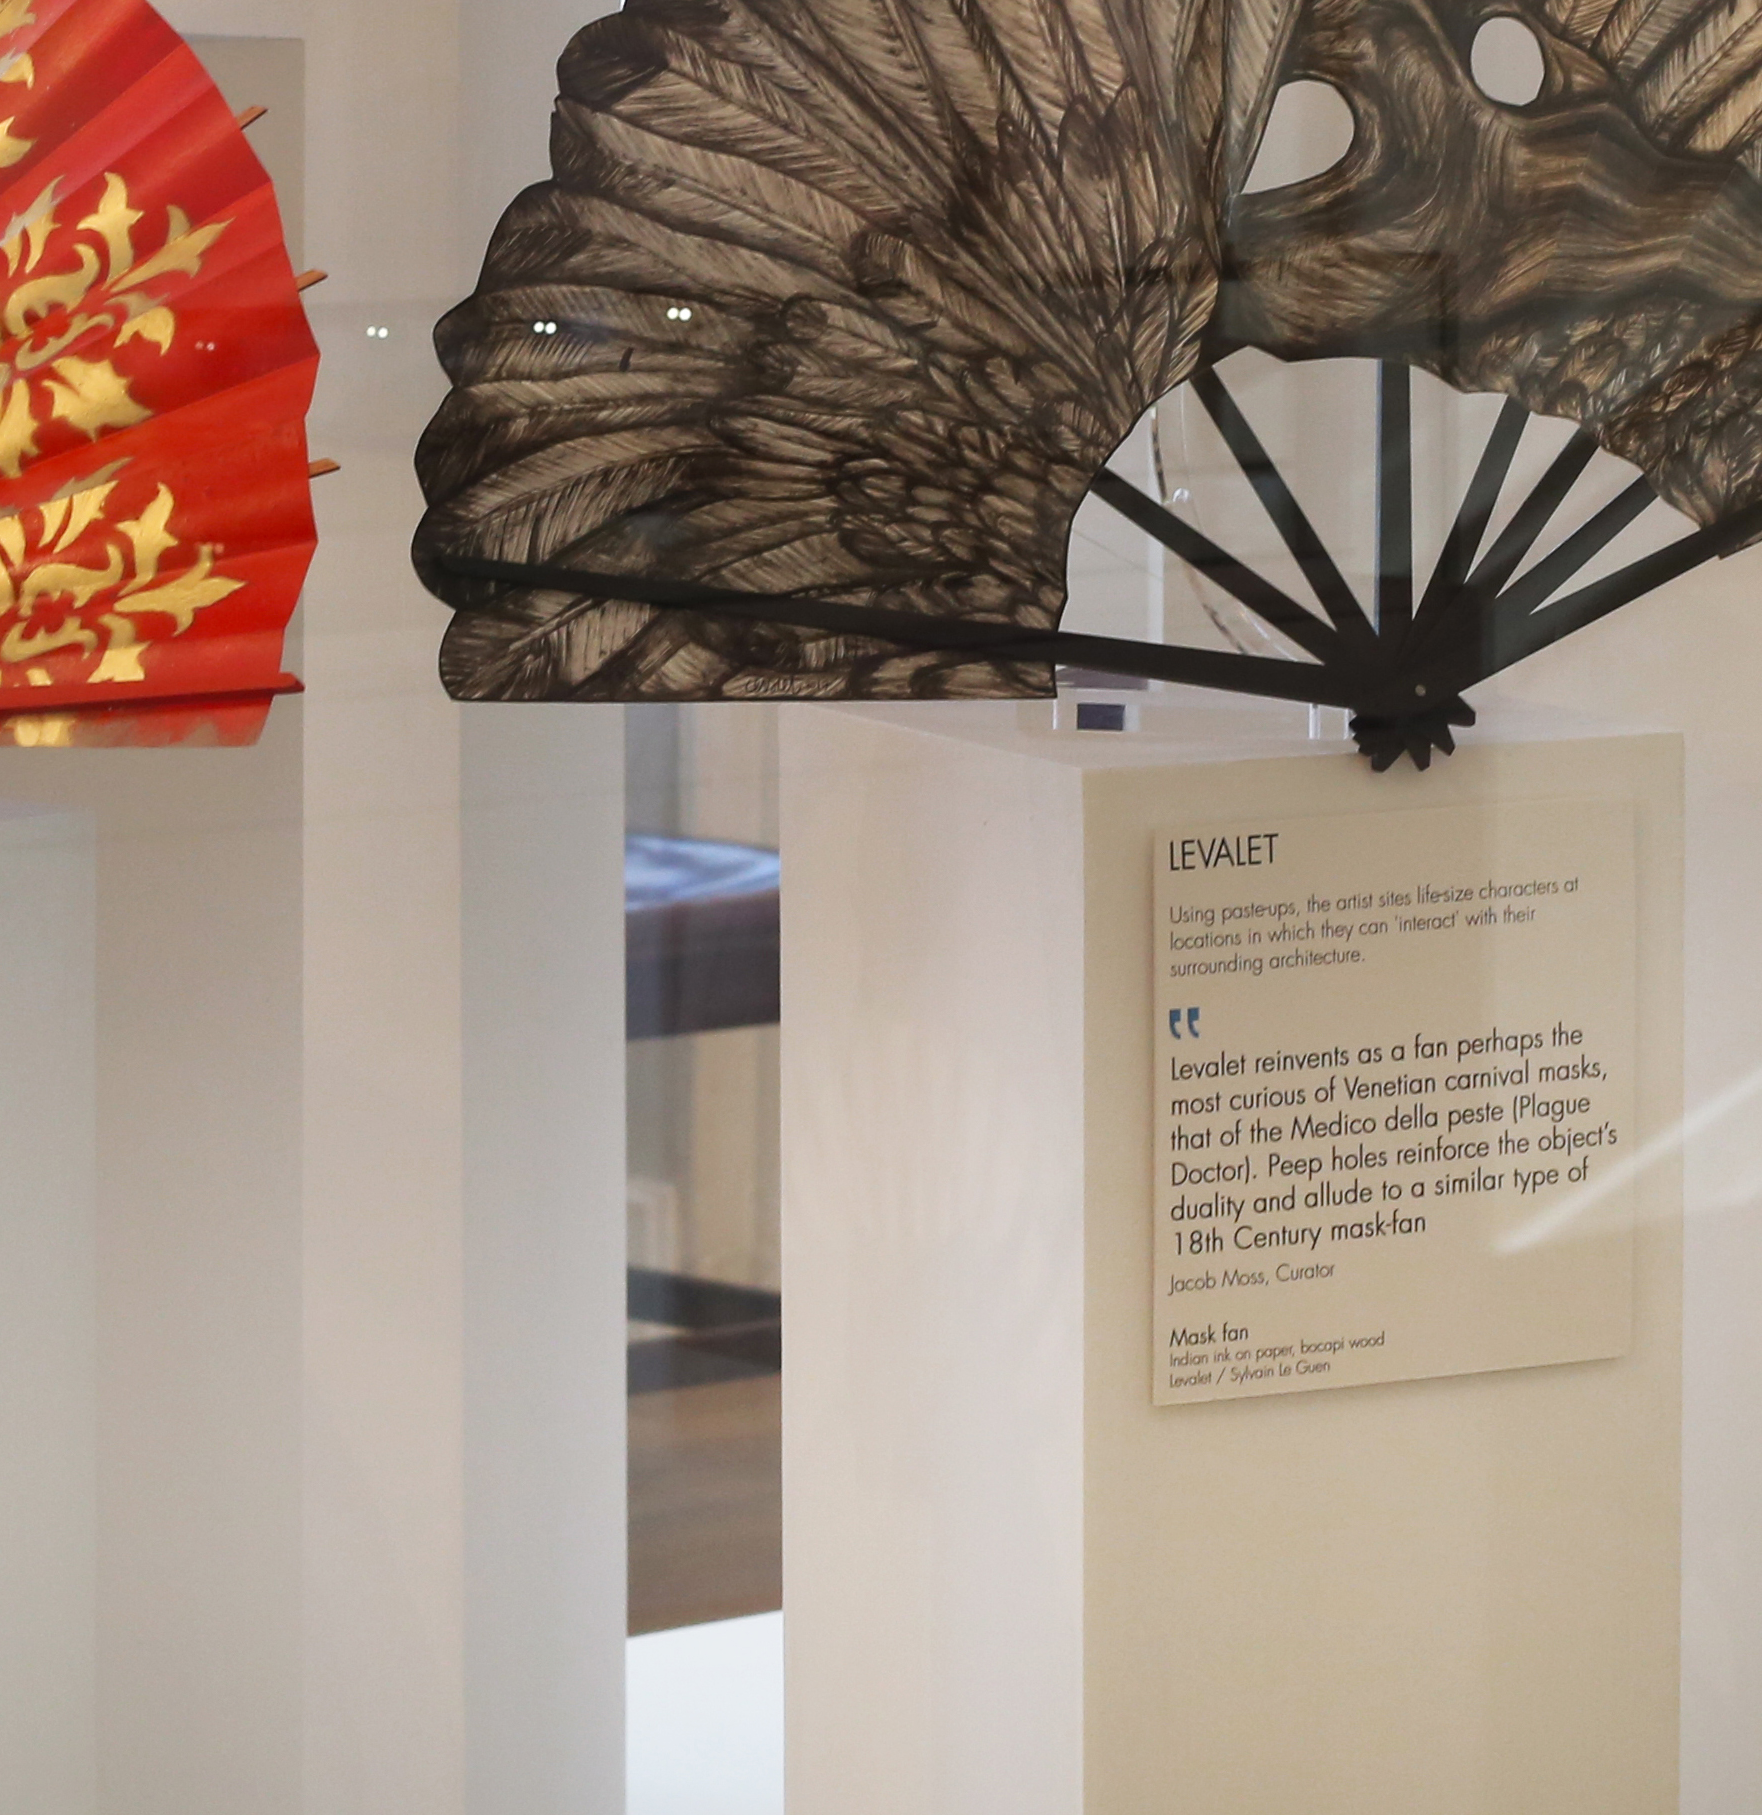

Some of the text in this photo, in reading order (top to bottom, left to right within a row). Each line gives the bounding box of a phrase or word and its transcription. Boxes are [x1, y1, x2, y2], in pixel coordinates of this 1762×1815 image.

[1169, 833, 1278, 871] LEVALET
[1169, 905, 1215, 927] Using
[1307, 893, 1331, 913] the
[1336, 893, 1373, 911] artist
[1378, 891, 1411, 908] sites
[1478, 879, 1559, 900] characters
[1563, 876, 1579, 893] at
[1170, 931, 1242, 950] locations
[1248, 928, 1262, 944] in
[1267, 920, 1315, 942] which
[1321, 918, 1354, 942] they
[1358, 921, 1388, 935] can
[1465, 905, 1497, 926] with
[1503, 904, 1535, 923] their
[1170, 952, 1263, 977] surrounding
[1171, 1021, 1583, 1081] Levalet reinvents as a fan perhaps the
[1171, 1092, 1220, 1115] most
[1229, 1086, 1306, 1111] curious
[1314, 1076, 1335, 1103] of
[1343, 1074, 1436, 1100] Venetian
[1444, 1060, 1529, 1091] carnival
[1171, 1124, 1211, 1151] that
[1219, 1118, 1241, 1147] of
[1250, 1117, 1282, 1144] the
[1290, 1110, 1376, 1140] Medico
[1384, 1102, 1438, 1131] della
[1448, 1102, 1503, 1133] peste
[1268, 1152, 1322, 1181] Peep
[1332, 1143, 1387, 1171] holes
[1397, 1136, 1489, 1164] reinforce
[1498, 1130, 1529, 1155] the
[1170, 1156, 1588, 1223] duality and allude to a similar type of
[1175, 1227, 1223, 1255] 18th
[1233, 1225, 1321, 1250] Century
[1168, 1270, 1217, 1295] Jacob
[1275, 1262, 1335, 1282] Curator
[1169, 1321, 1248, 1347] Mask fan
